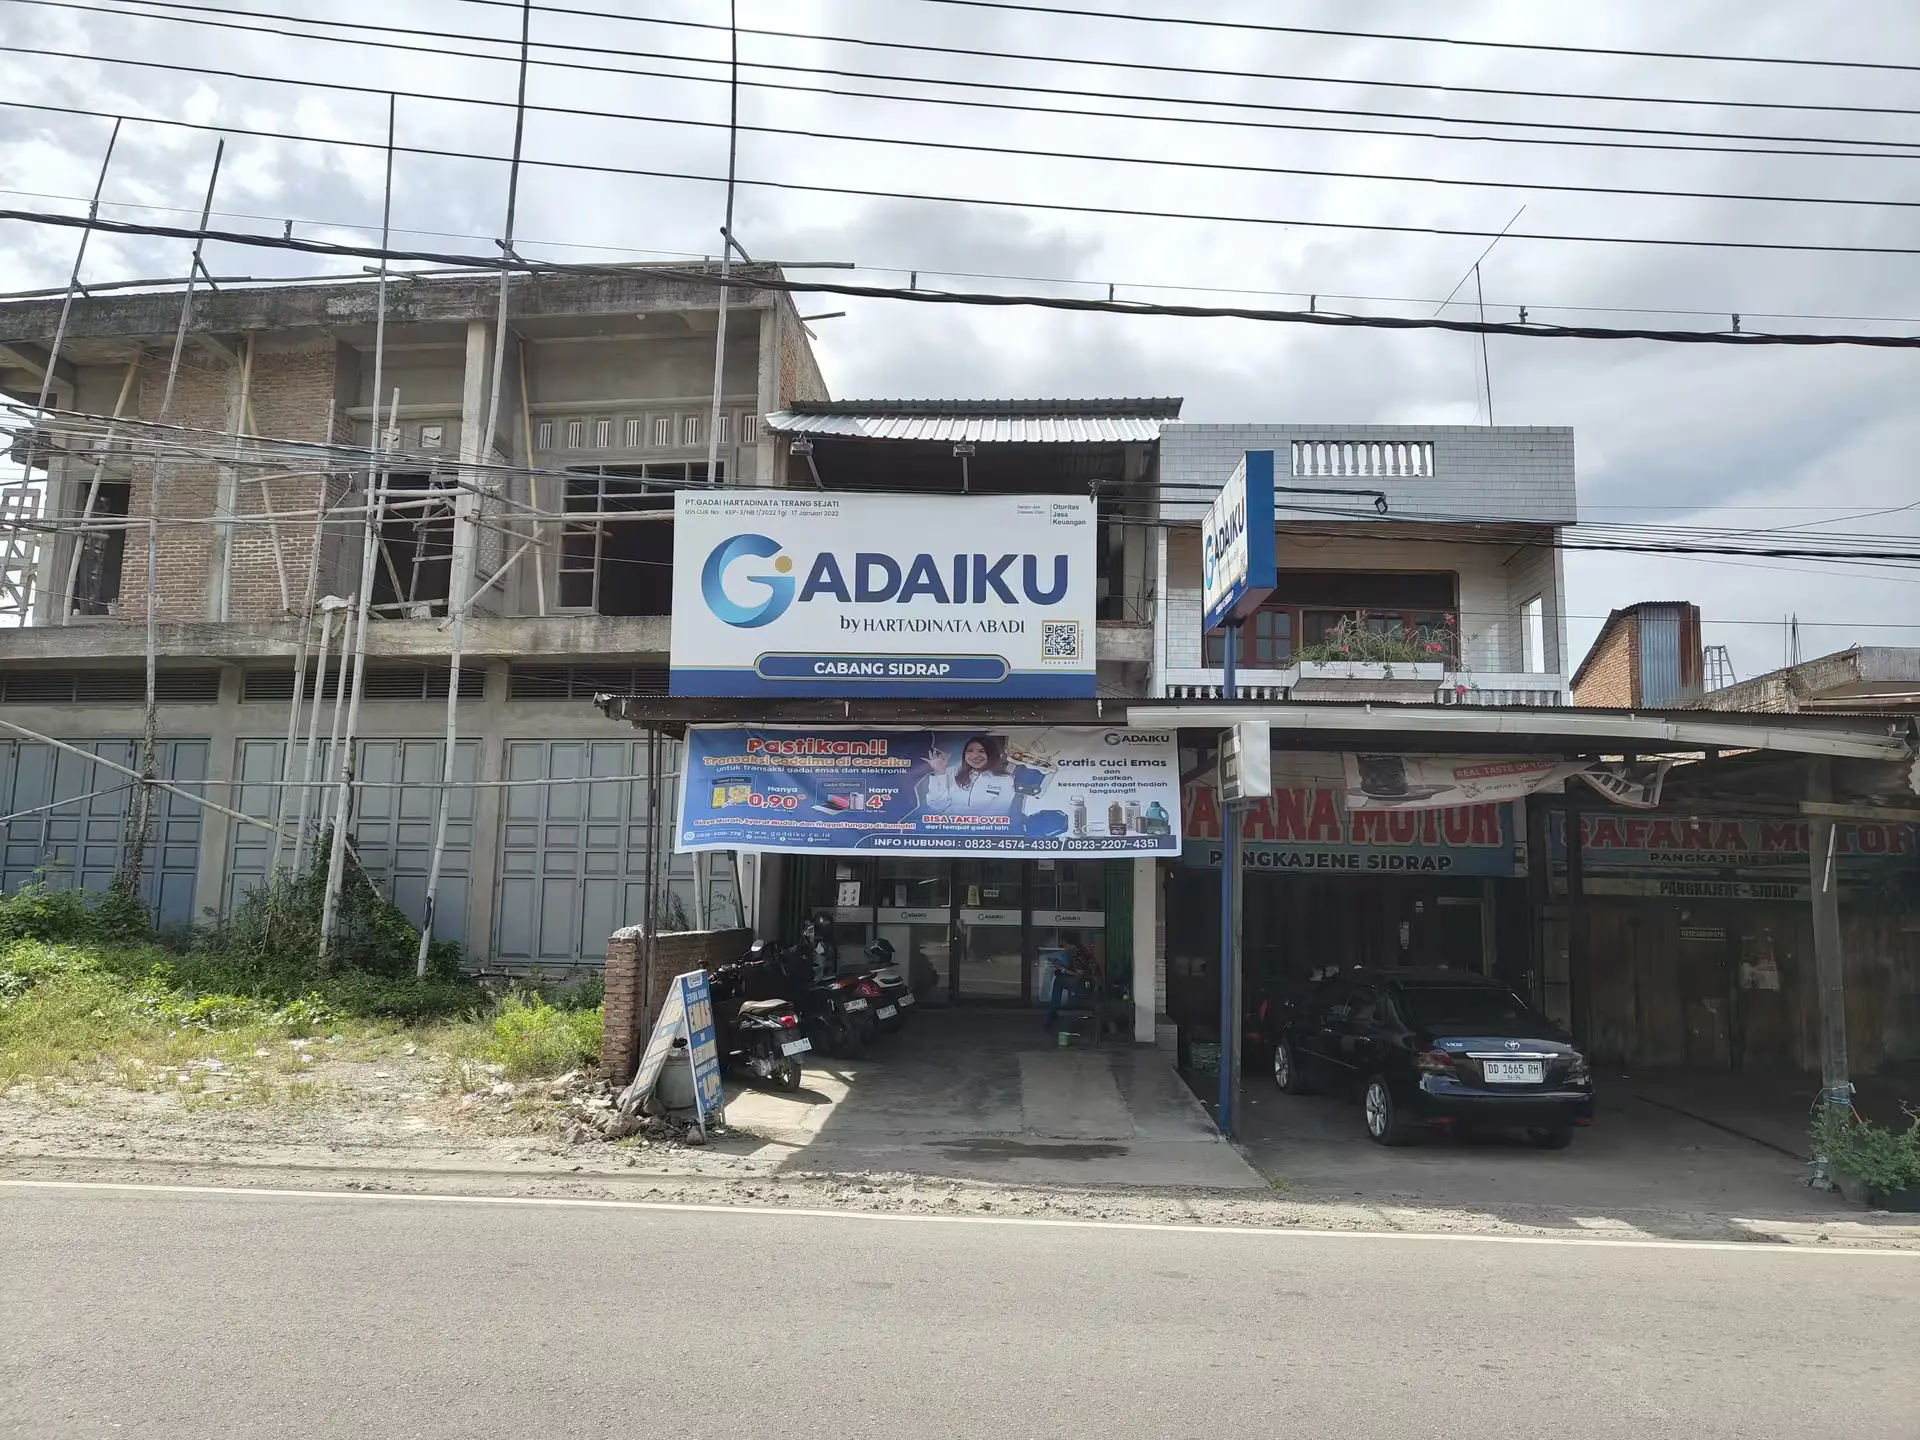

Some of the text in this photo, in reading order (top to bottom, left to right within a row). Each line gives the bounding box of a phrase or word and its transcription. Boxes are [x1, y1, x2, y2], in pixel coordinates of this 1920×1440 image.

[840, 615, 1025, 634] by HARTADINATA ABADI
[814, 661, 950, 676] CABANG SIDRAP
[746, 738, 888, 756] Pastikan!!
[703, 754, 770, 766] Transaksi
[836, 756, 852, 767] di
[852, 757, 912, 768] Gadaiku
[1057, 758, 1167, 767] Gratis Cuci Emas
[744, 764, 784, 772] transaksi
[787, 766, 813, 774] gadai
[861, 766, 908, 774] elektronik
[1456, 768, 1482, 778] REAL
[1484, 764, 1514, 774] TASTE
[768, 786, 798, 794] Hanya
[922, 814, 1010, 825] BISA TAKE OVER
[1182, 786, 1341, 841] AANA
[874, 838, 902, 846] INFO
[904, 838, 956, 848] HUBUNGI
[964, 839, 1058, 850] 0823-4574-4330
[1068, 838, 1158, 850] 0823-2207-4351
[1209, 850, 1452, 870] PNGKAJENE SIDRAP
[1660, 881, 1742, 896] PANGKAJENE
[1751, 884, 1798, 898] SIDRAP
[1488, 1064, 1539, 1074] DD 1665 RH
